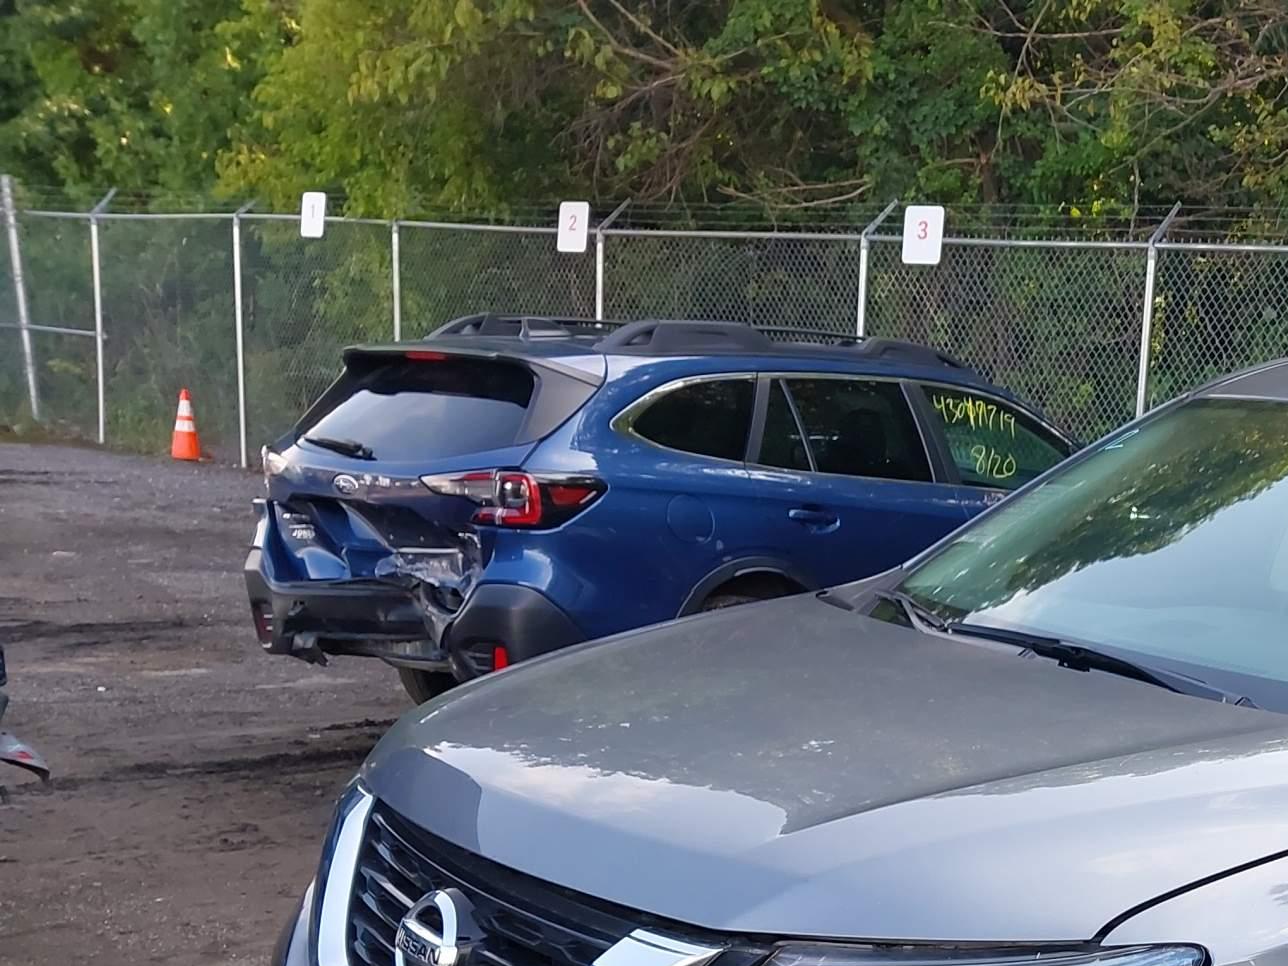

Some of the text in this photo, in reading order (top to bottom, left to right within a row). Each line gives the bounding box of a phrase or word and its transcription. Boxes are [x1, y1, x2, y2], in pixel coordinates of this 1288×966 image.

[568, 214, 578, 232] 2
[917, 220, 929, 240] 3
[971, 444, 1017, 478] 8/20
[395, 926, 441, 966] NISSAN
